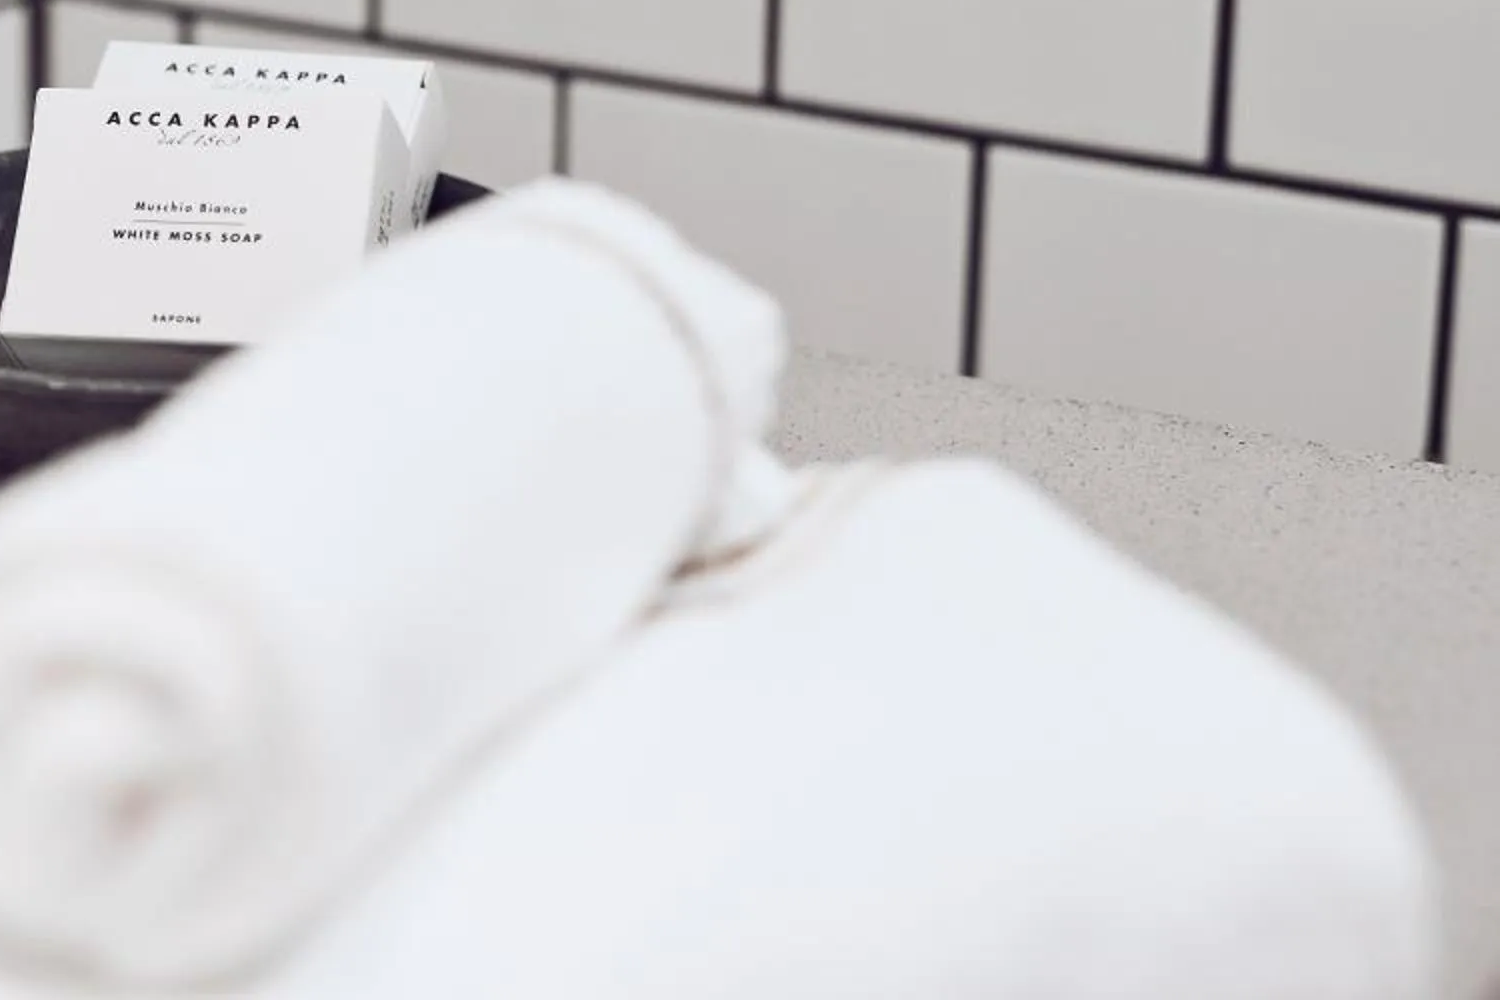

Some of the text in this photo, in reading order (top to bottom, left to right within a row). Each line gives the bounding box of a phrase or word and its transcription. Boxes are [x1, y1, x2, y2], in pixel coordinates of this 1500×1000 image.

[165, 62, 346, 85] ACCA KAPPA
[106, 110, 301, 130] ACCA KAPPA
[133, 201, 248, 215] Muschio Bianco
[112, 229, 263, 244] WHITE MOSS SOAP
